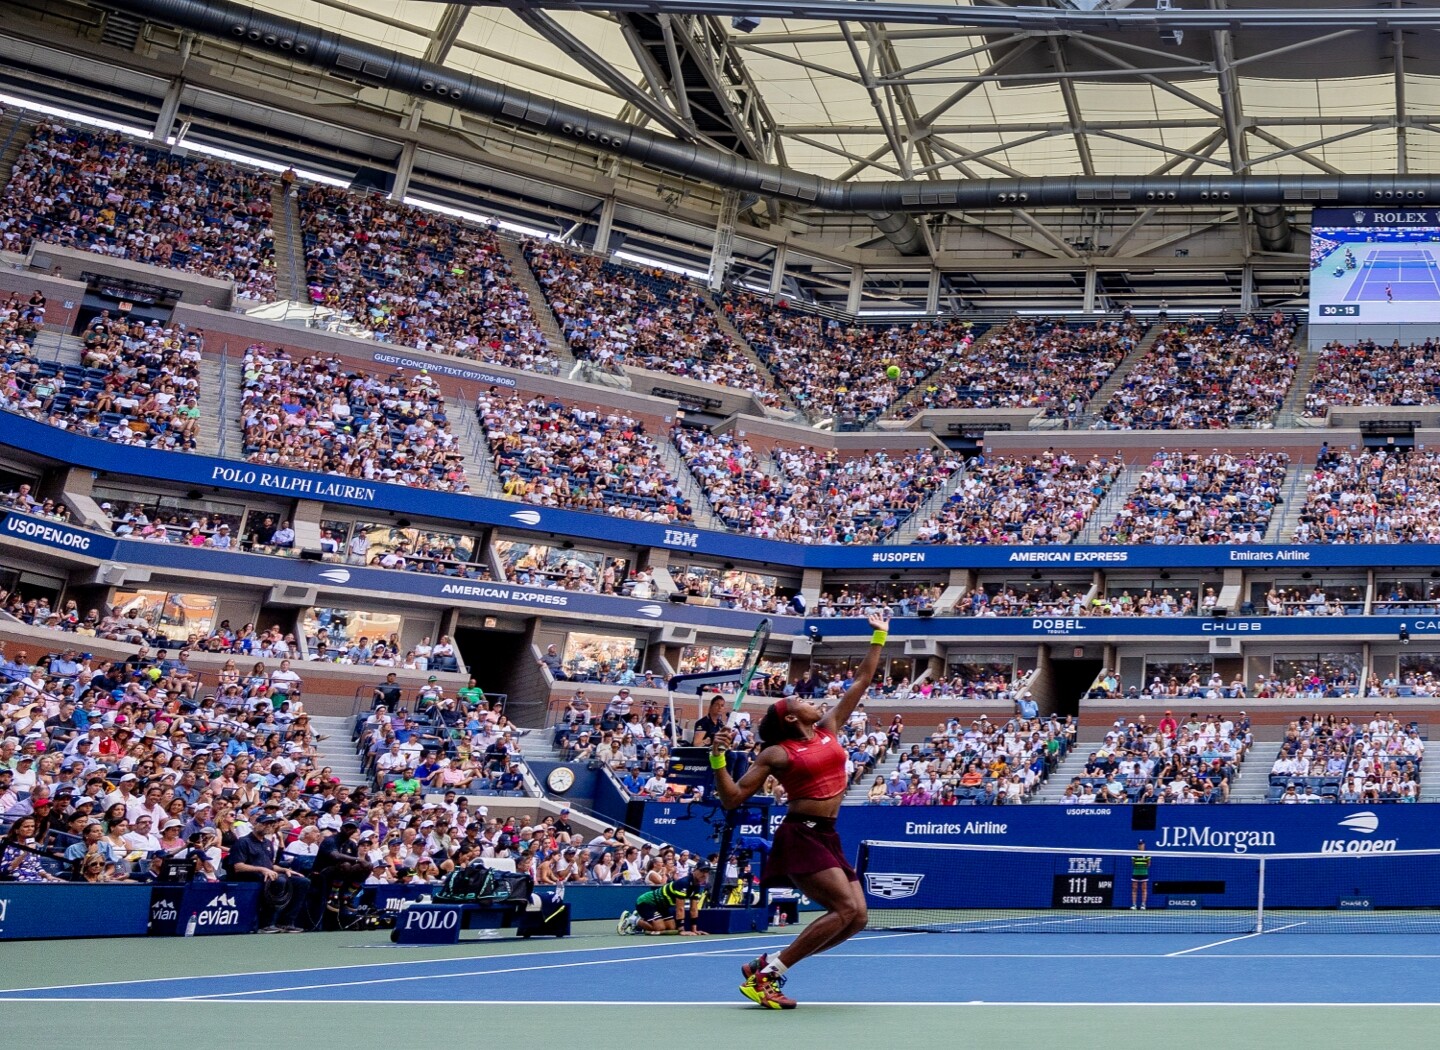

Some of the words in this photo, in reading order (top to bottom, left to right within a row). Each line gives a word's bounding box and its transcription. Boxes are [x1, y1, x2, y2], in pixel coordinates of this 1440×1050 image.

[1374, 213, 1427, 222] ROLEX
[374, 352, 400, 364] GUEST
[401, 358, 443, 373] CONCERN?
[443, 367, 463, 377] TEXT
[462, 371, 516, 387] (917)708-8080
[212, 466, 256, 485] POLO
[260, 472, 311, 491] RALPH
[315, 480, 376, 500] LAUREN
[7, 517, 90, 549] USOPEN.ORG
[663, 530, 698, 547] IBM
[872, 553, 925, 562] #USOPEN
[1009, 553, 1071, 561] AMERICAN
[1074, 552, 1127, 561] EXPRESS
[1230, 551, 1274, 560] Emirates
[1276, 551, 1310, 560] Airline
[441, 583, 508, 600] AMERICAN
[512, 590, 568, 605] EXPRESS
[906, 822, 960, 834] Emirates
[964, 821, 1007, 834] Airline
[1156, 827, 1276, 853] J.P.Morgan
[1321, 840, 1345, 852] us
[1346, 840, 1396, 852] open
[1068, 858, 1102, 873] IBM
[1069, 878, 1087, 892] 111
[153, 908, 177, 920] vian
[198, 908, 238, 925] evian
[405, 911, 457, 929] POLO
